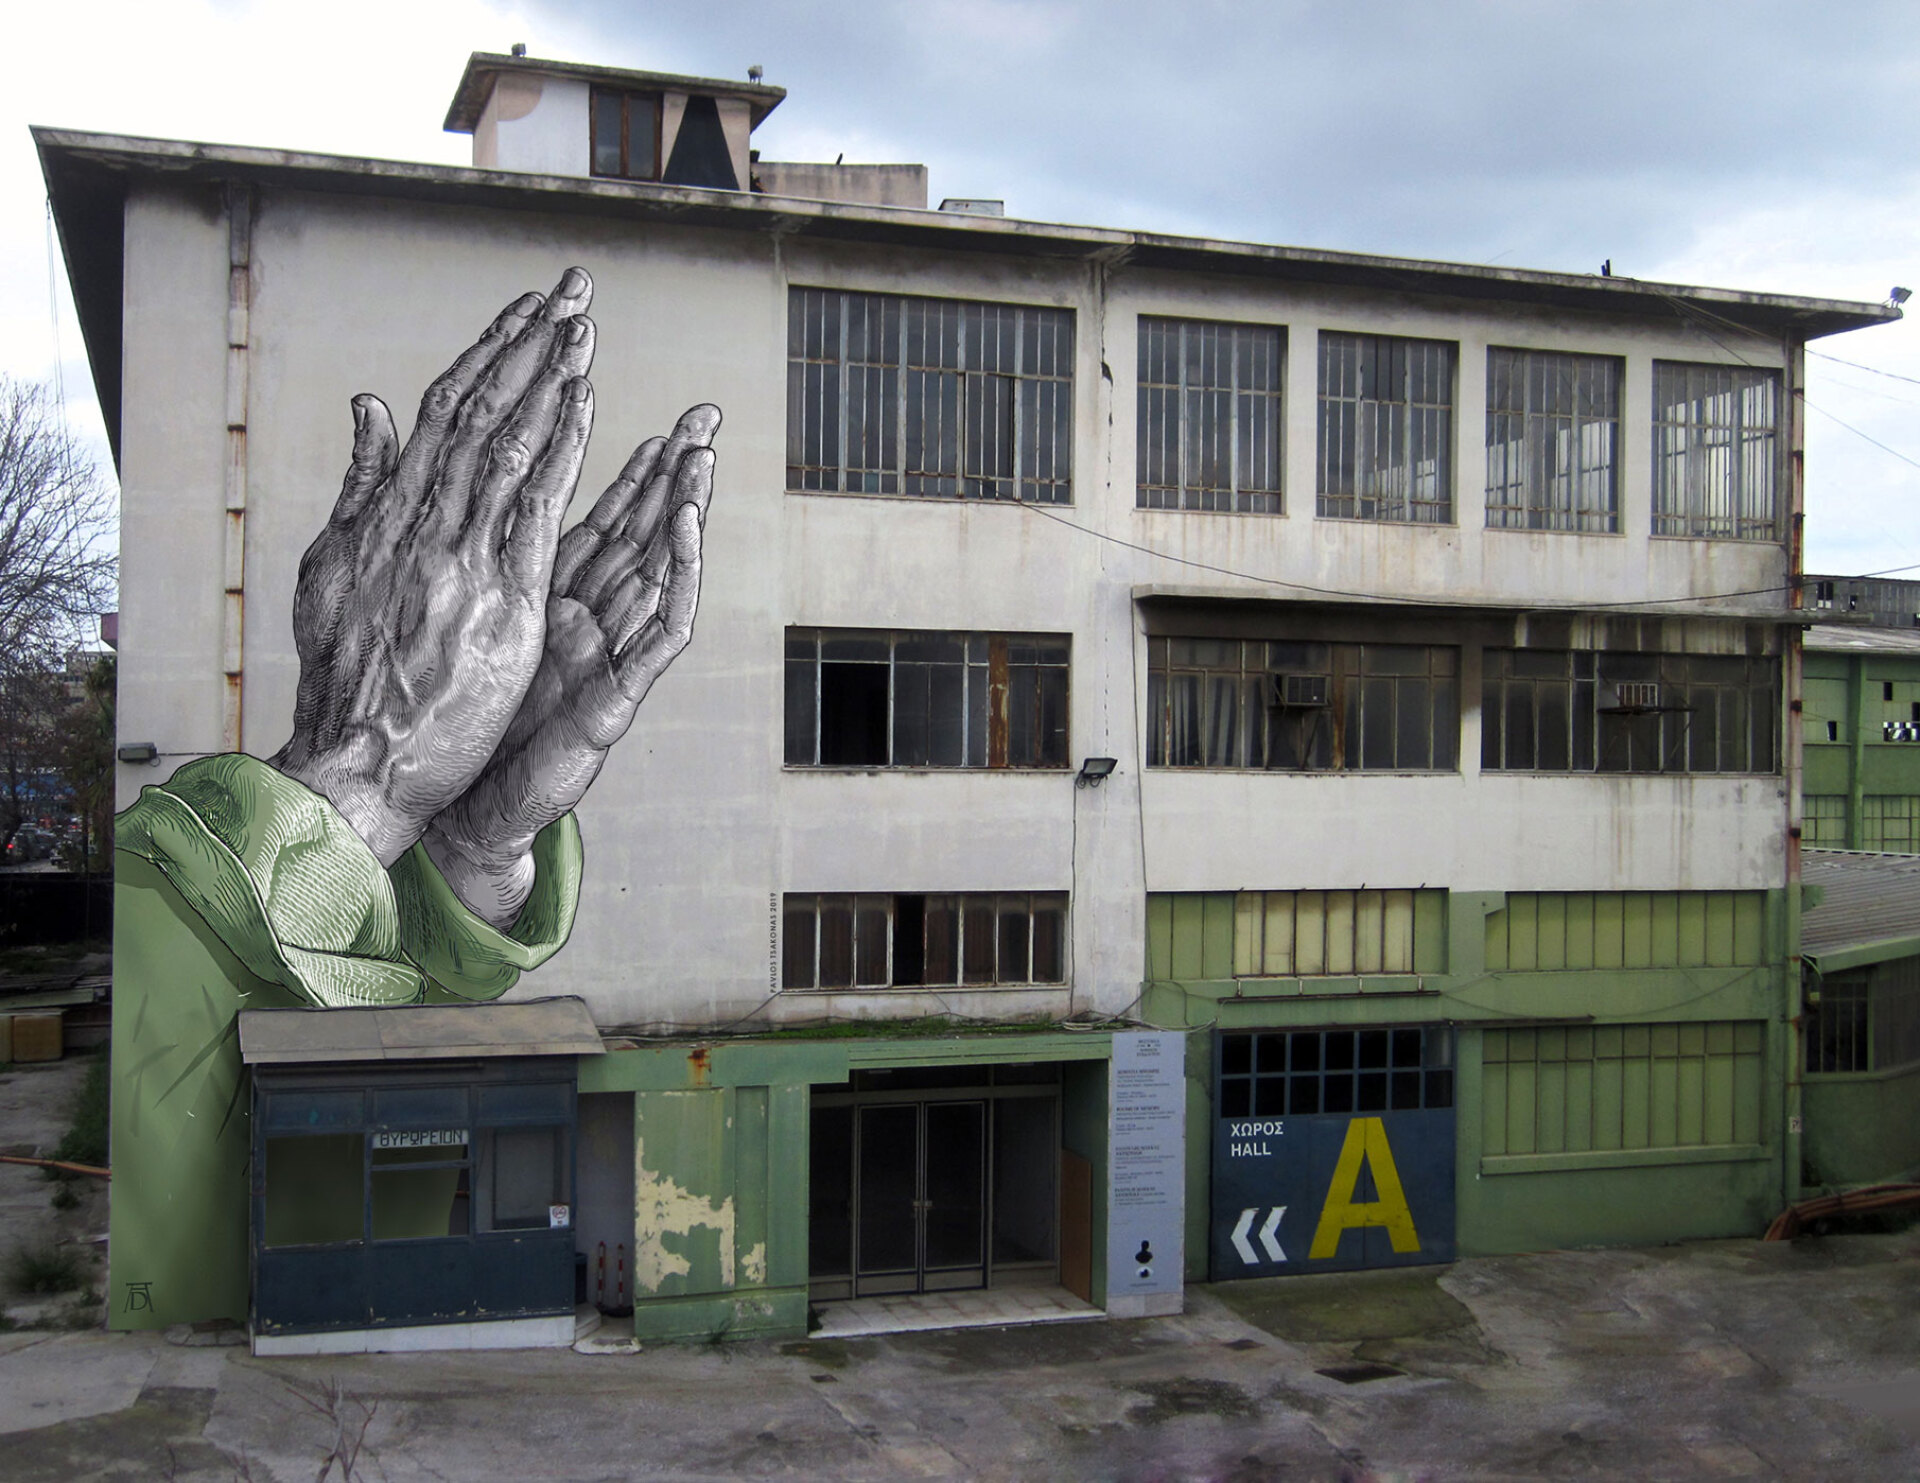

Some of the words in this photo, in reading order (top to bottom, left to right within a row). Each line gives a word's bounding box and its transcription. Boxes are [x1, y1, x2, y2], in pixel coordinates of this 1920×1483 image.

[769, 892, 777, 913] 2019
[769, 914, 777, 959] TSAKONAS
[769, 961, 777, 994] PAVLOS
[1231, 1121, 1284, 1137] ΧΩΡΟΣ
[1231, 1142, 1272, 1157] HALL
[1308, 1116, 1422, 1260] A
